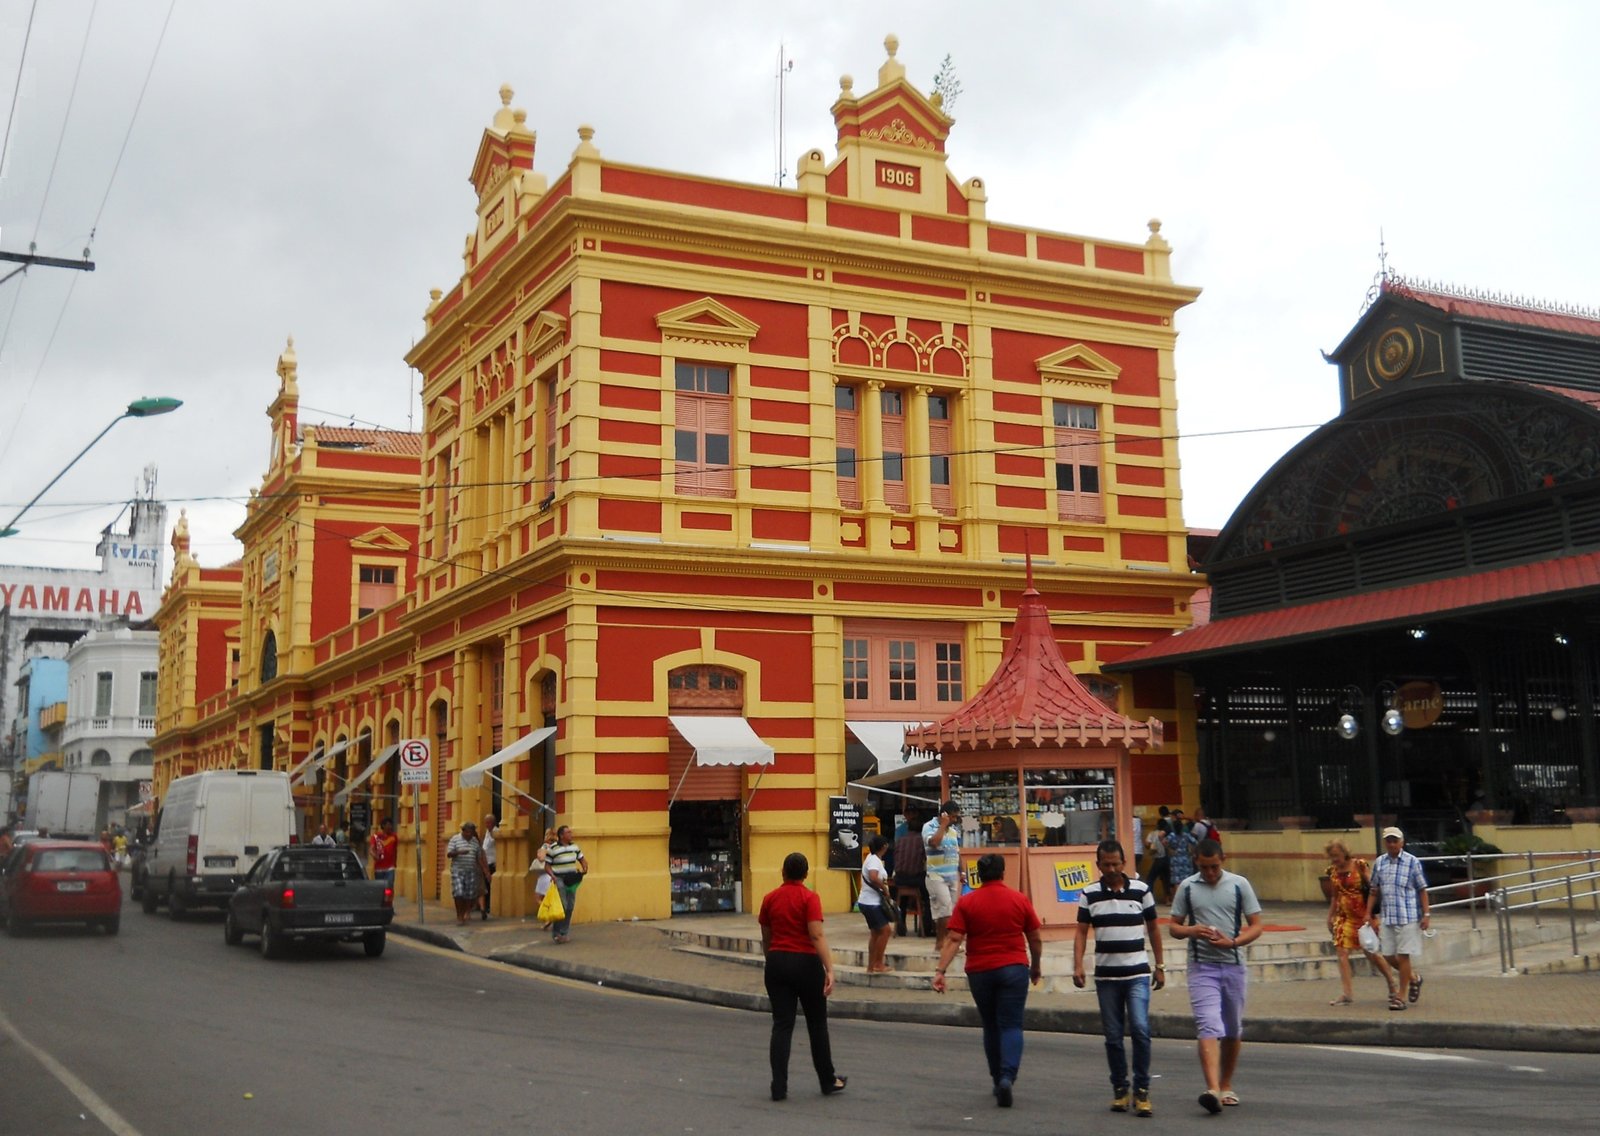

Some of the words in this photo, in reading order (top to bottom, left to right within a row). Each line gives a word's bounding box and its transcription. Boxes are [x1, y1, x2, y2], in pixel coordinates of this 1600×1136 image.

[881, 167, 914, 187] 1906
[0, 583, 144, 615] YAMAHA
[969, 872, 980, 886] TI
[1060, 871, 1084, 887] TIM
